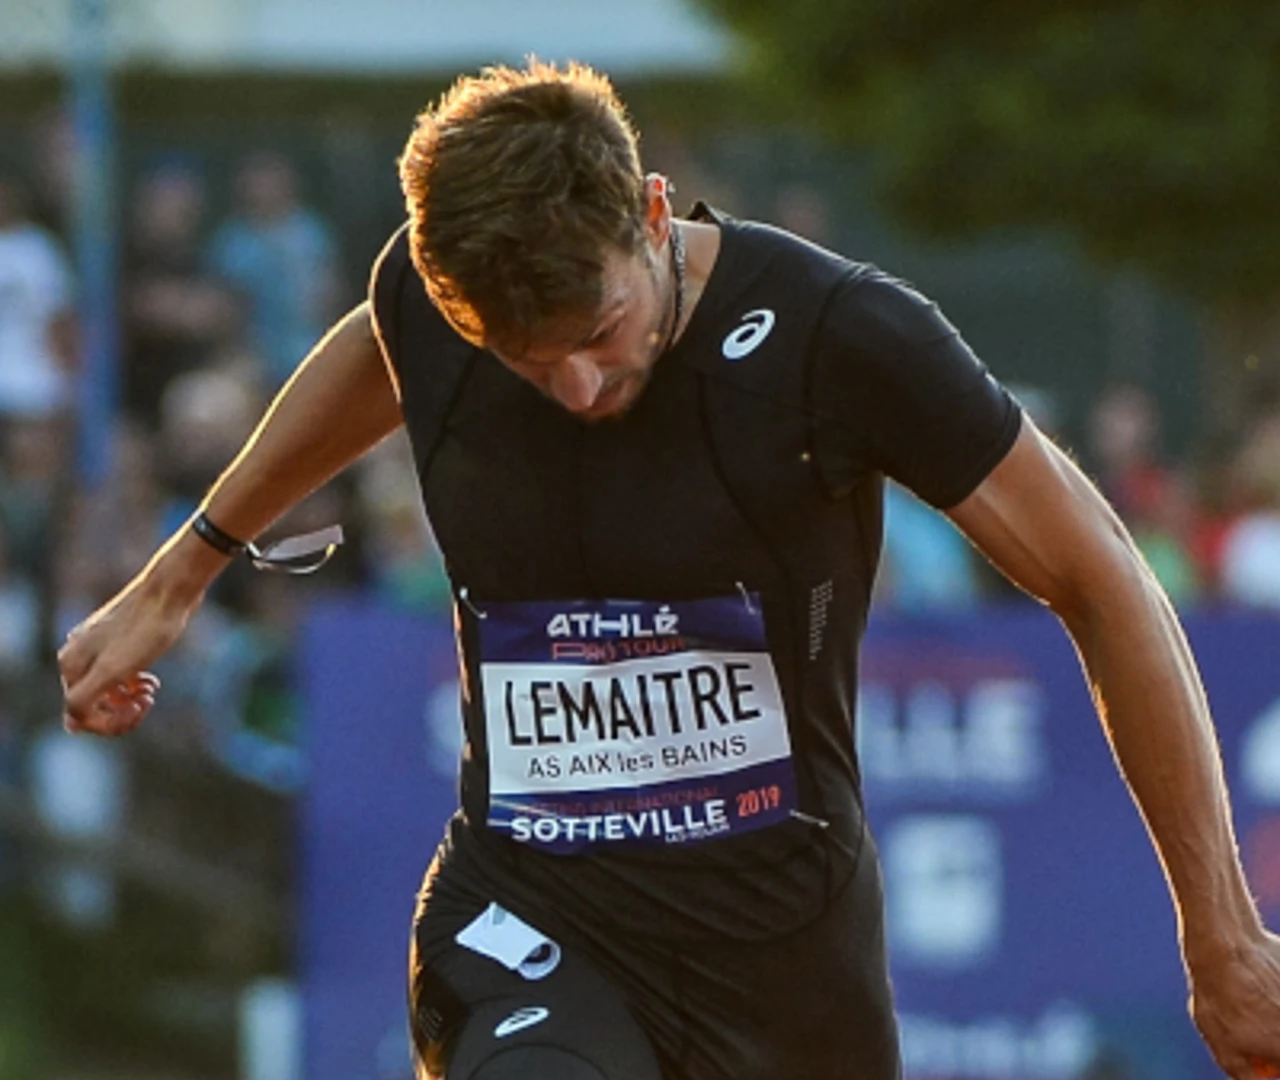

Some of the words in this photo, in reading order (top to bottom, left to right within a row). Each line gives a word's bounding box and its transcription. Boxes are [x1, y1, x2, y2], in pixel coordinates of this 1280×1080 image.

[547, 605, 679, 638] ATHLÉ
[505, 664, 761, 746] LEMAITRE
[528, 756, 561, 779] AS
[570, 754, 612, 776] AIX
[618, 750, 654, 772] les
[662, 735, 747, 767] BAINS
[511, 799, 726, 842] SOTTEVILLE
[736, 786, 781, 818] 2019
